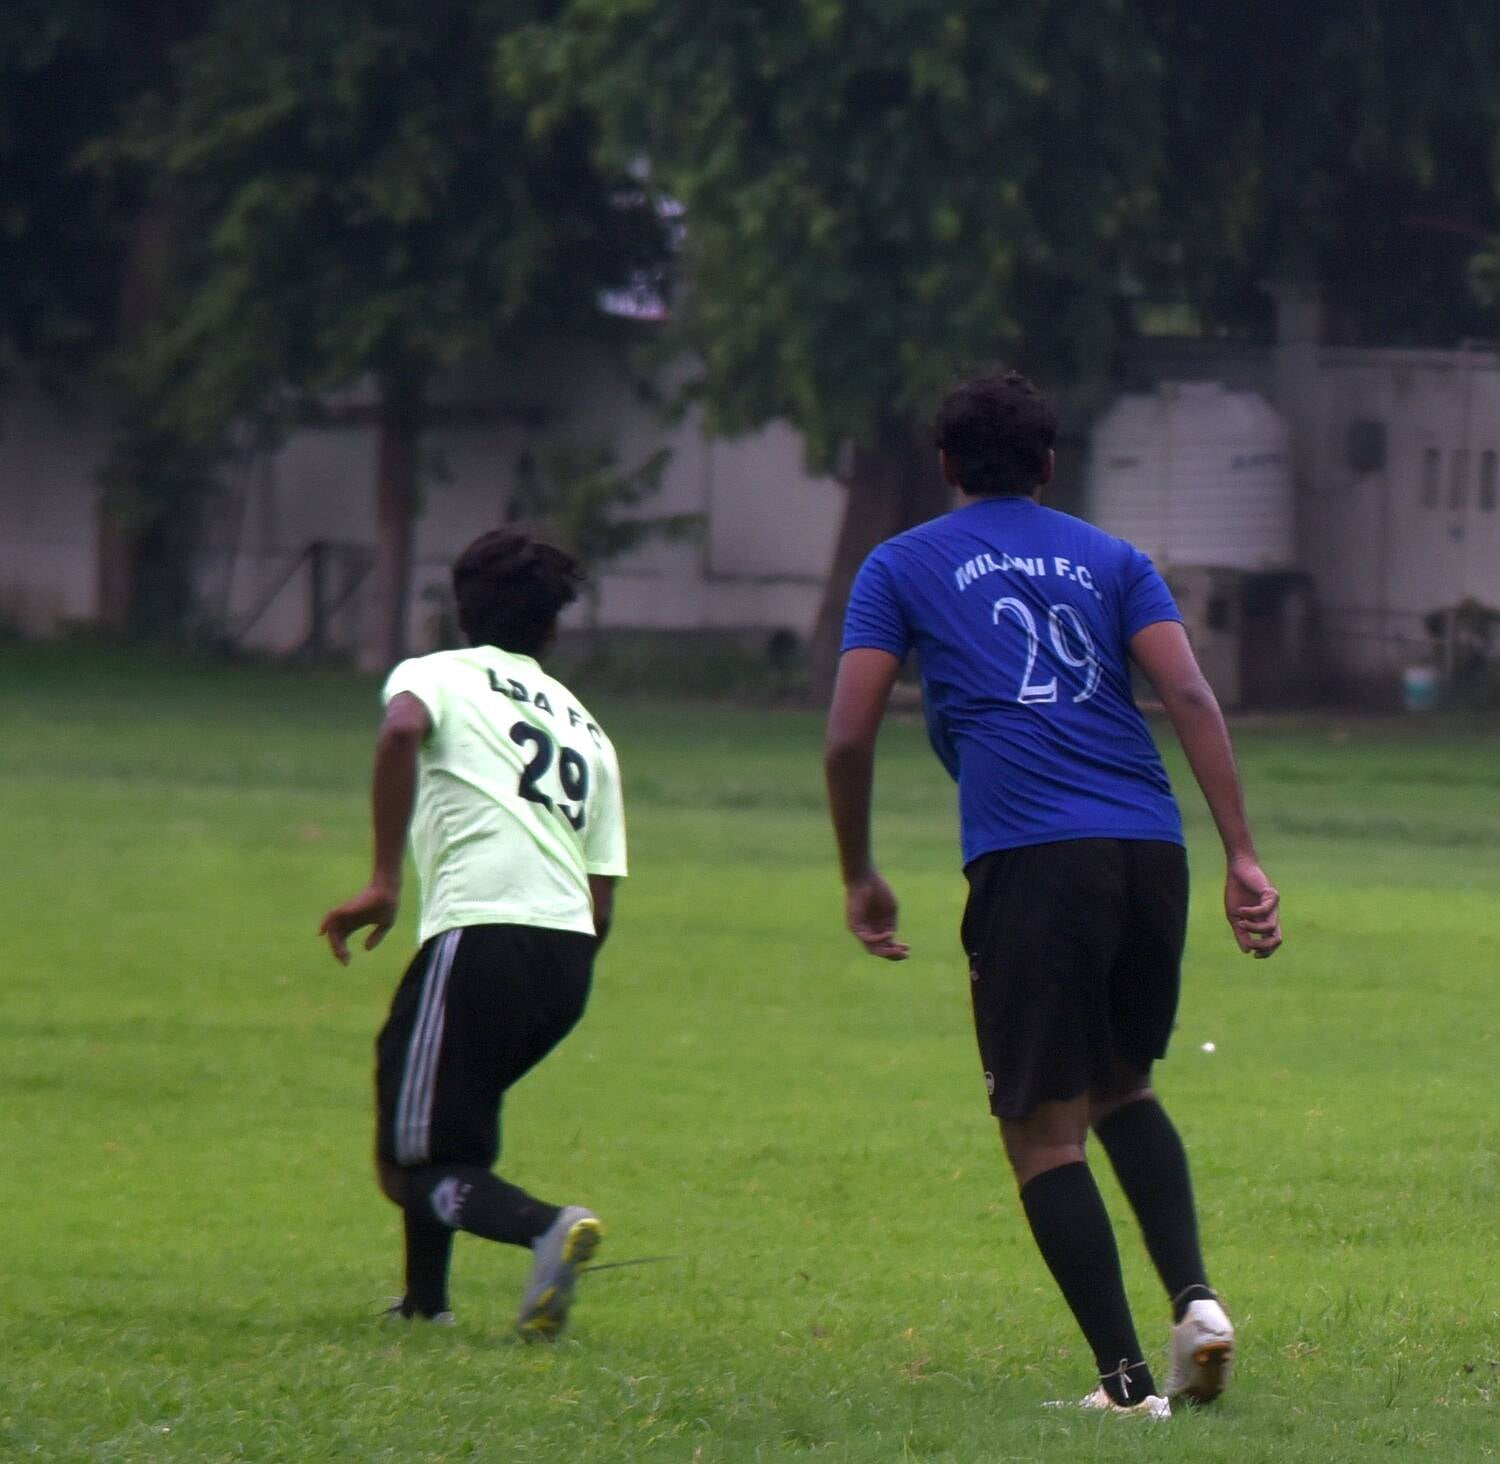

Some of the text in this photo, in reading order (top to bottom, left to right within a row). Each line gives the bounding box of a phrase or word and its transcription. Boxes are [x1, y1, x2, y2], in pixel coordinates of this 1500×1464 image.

[954, 553, 1046, 592] MILANI
[993, 597, 1103, 704] 29
[509, 720, 588, 832] 29
